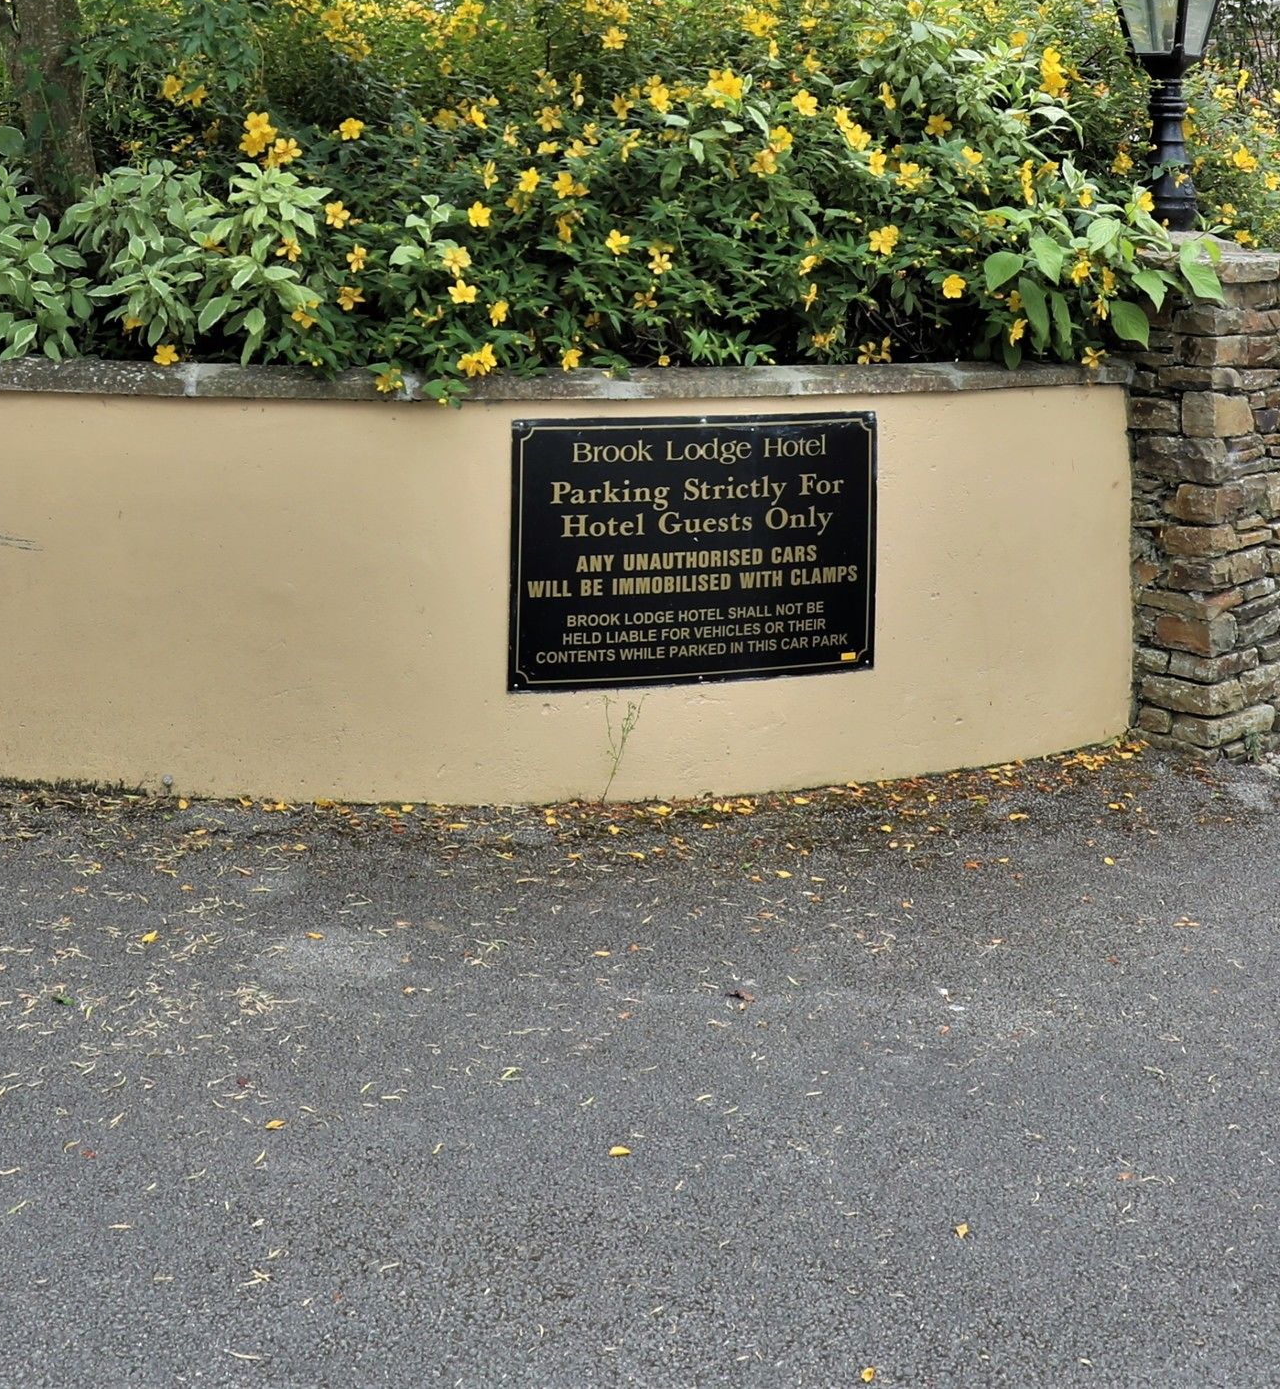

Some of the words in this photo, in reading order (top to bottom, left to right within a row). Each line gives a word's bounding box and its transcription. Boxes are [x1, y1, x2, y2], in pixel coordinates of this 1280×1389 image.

[573, 440, 652, 462] Brook
[667, 438, 751, 464] Lodge
[764, 434, 825, 457] Hotel
[551, 480, 670, 510] Parking
[684, 476, 786, 505] Strictly
[800, 474, 843, 495] For
[561, 513, 644, 537] Hotel
[659, 512, 752, 534] Guests
[766, 506, 832, 535] Only
[576, 555, 614, 572] ANY
[624, 549, 762, 570] UNAUTHORISED
[772, 545, 816, 563] CARS
[528, 581, 571, 597] WILL
[581, 579, 602, 596] BE
[613, 574, 731, 595] IMMOBILISED
[740, 571, 782, 588] WITH
[791, 566, 857, 585] CLAMPS
[568, 614, 619, 626] BROOK
[625, 611, 673, 624] LODGE
[679, 609, 723, 621] HOTEL
[729, 606, 771, 619] SHALL
[777, 603, 802, 615] NOT
[807, 602, 823, 613] BE
[563, 633, 601, 644] HELD
[607, 630, 656, 643] LIABLE
[662, 628, 689, 640] FOR
[694, 623, 760, 638] VEHICLES
[765, 622, 783, 633] OR
[789, 619, 825, 631] THEIR
[537, 650, 615, 663] CONTENTS
[620, 647, 664, 660] WHILE
[670, 643, 726, 657] PARKED
[731, 642, 742, 653] IN
[748, 640, 776, 651] THIS
[782, 637, 807, 649] CAR
[813, 634, 846, 646] PARK
